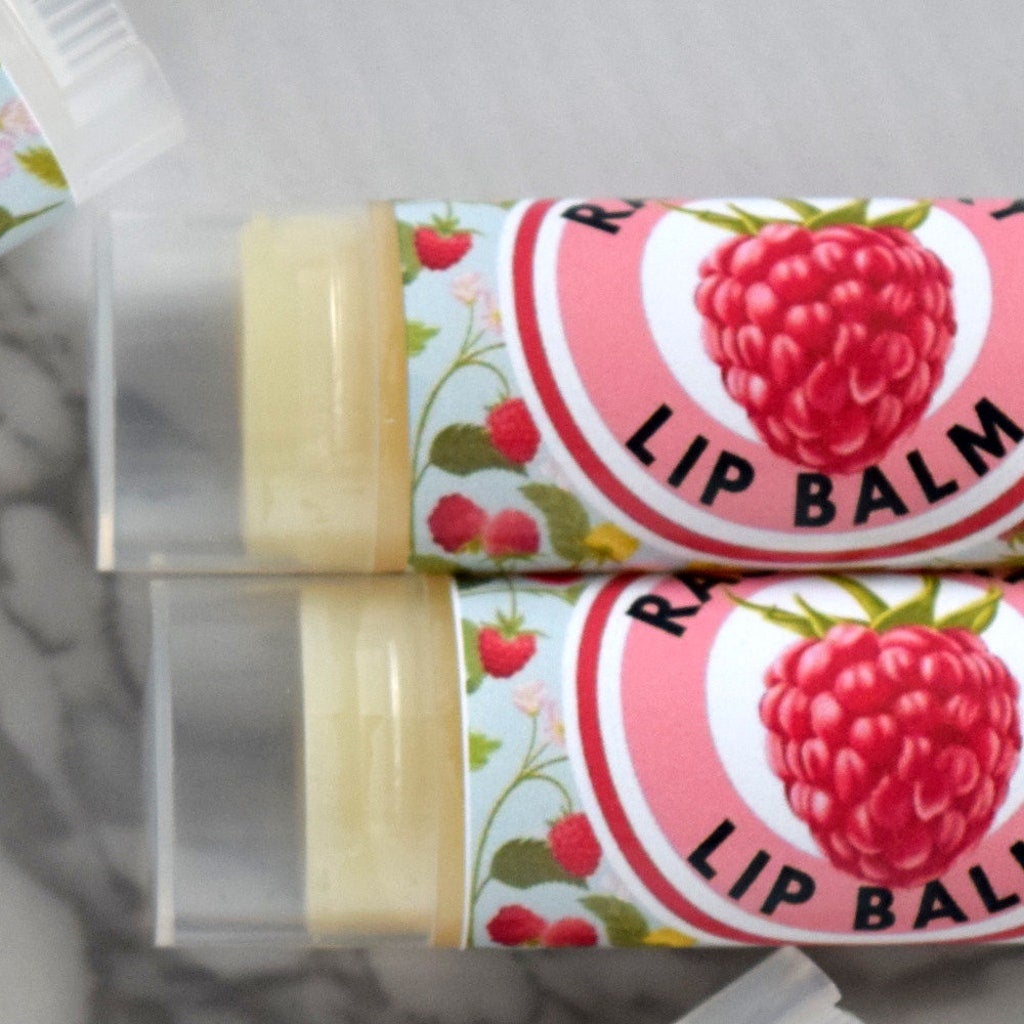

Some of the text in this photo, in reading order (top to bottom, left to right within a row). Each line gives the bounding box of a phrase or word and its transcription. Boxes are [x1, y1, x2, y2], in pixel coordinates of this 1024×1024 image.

[625, 397, 1024, 528] LIP BALM
[687, 819, 1024, 932] LIP BAL
